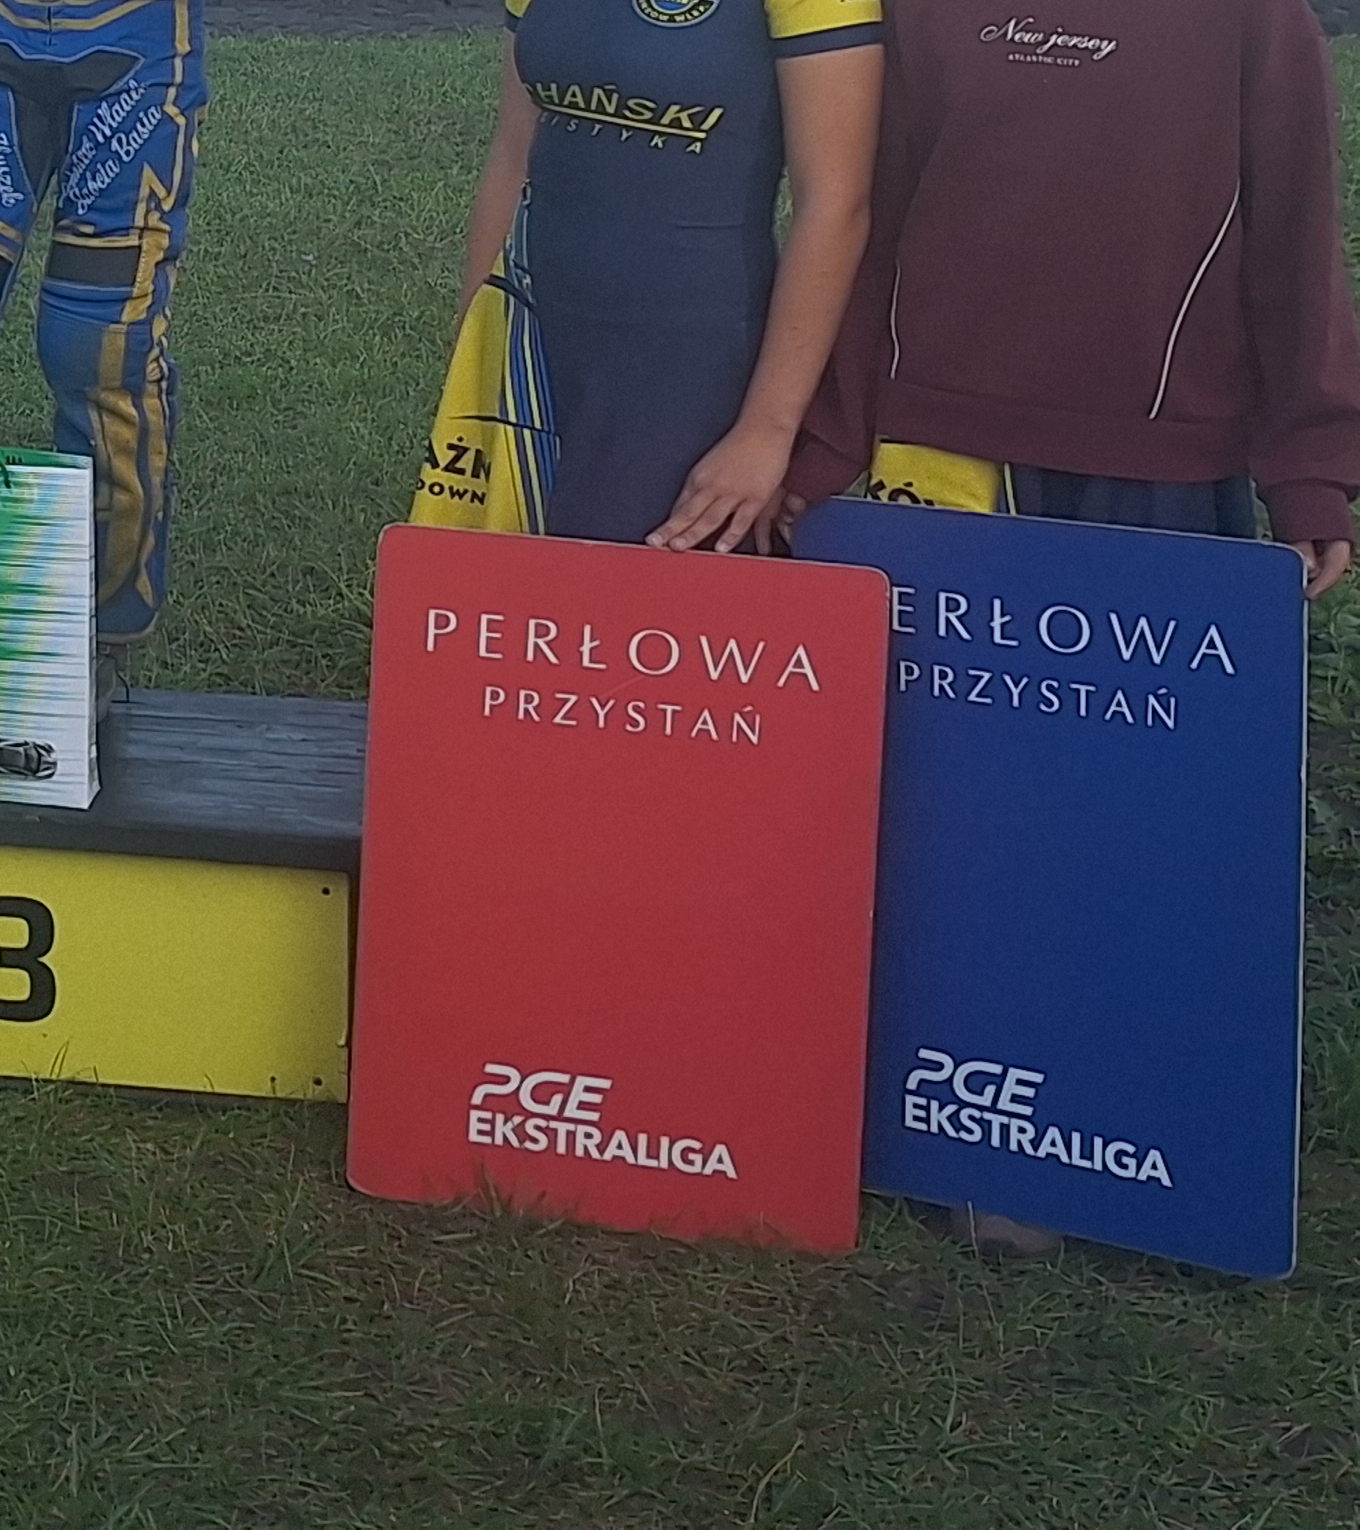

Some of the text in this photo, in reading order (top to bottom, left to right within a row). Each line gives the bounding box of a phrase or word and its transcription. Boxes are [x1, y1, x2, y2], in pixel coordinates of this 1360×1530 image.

[980, 17, 1118, 61] New jersey
[1056, 55, 1081, 67] CITY
[110, 104, 163, 164] Basia
[425, 607, 821, 692] PERŁOWA
[890, 585, 1237, 675] ERŁOWA
[483, 684, 763, 746] PRZYSTAŃ
[897, 659, 1179, 731] PRZYSTAŃ
[471, 1063, 612, 1122] PGE
[905, 1047, 1045, 1117] PGE
[467, 1111, 739, 1181] EKSTRALIGA
[903, 1094, 1174, 1188] EKSTRALIGA
